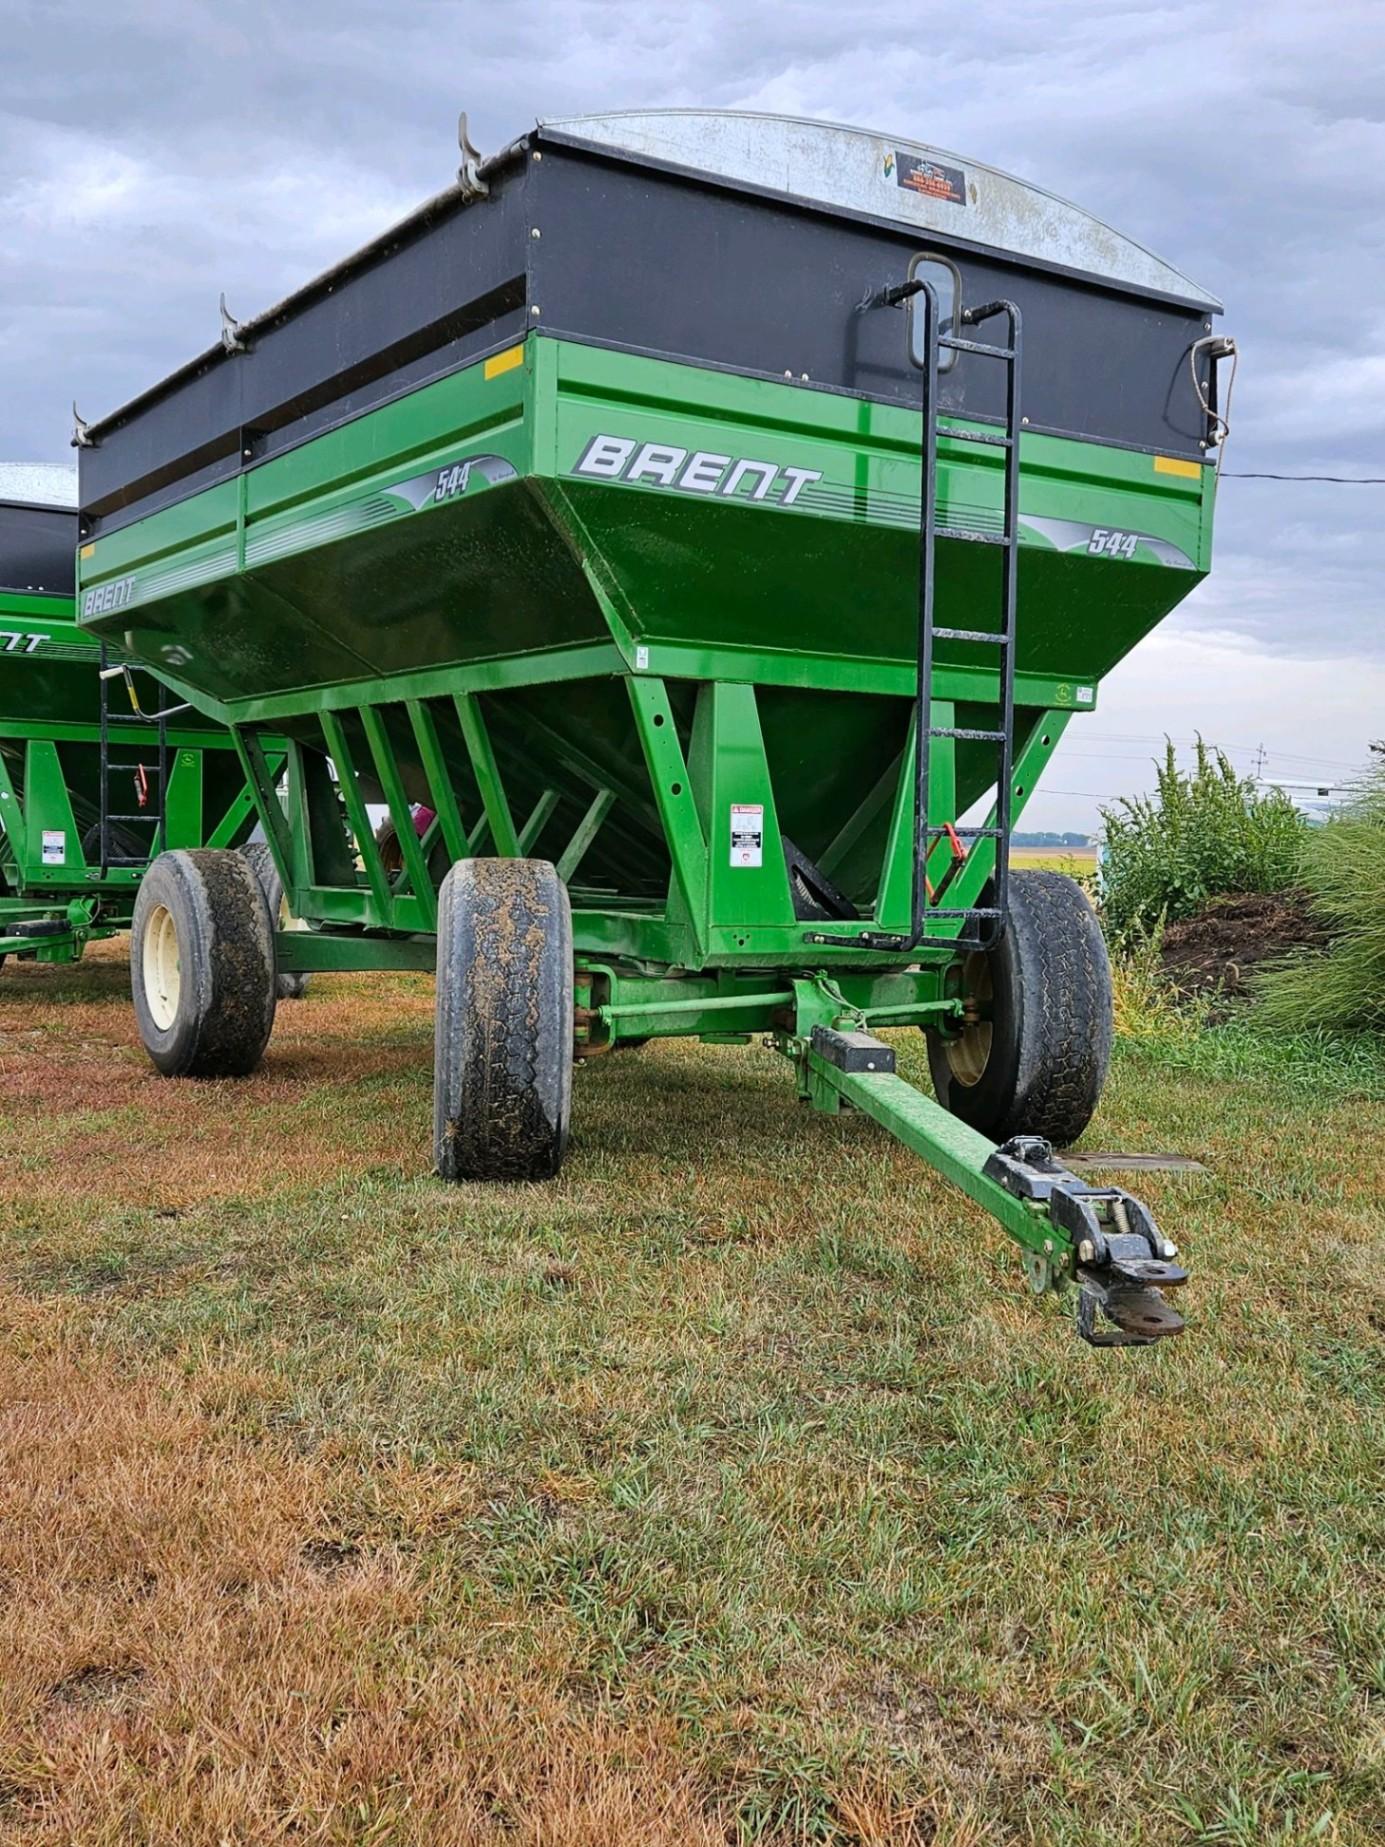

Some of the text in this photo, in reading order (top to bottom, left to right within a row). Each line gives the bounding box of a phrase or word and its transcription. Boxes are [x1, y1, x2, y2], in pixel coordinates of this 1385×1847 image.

[434, 461, 472, 502] 544
[571, 434, 824, 506] BRENT
[1087, 529, 1139, 560] 544
[83, 575, 136, 619] BRENT
